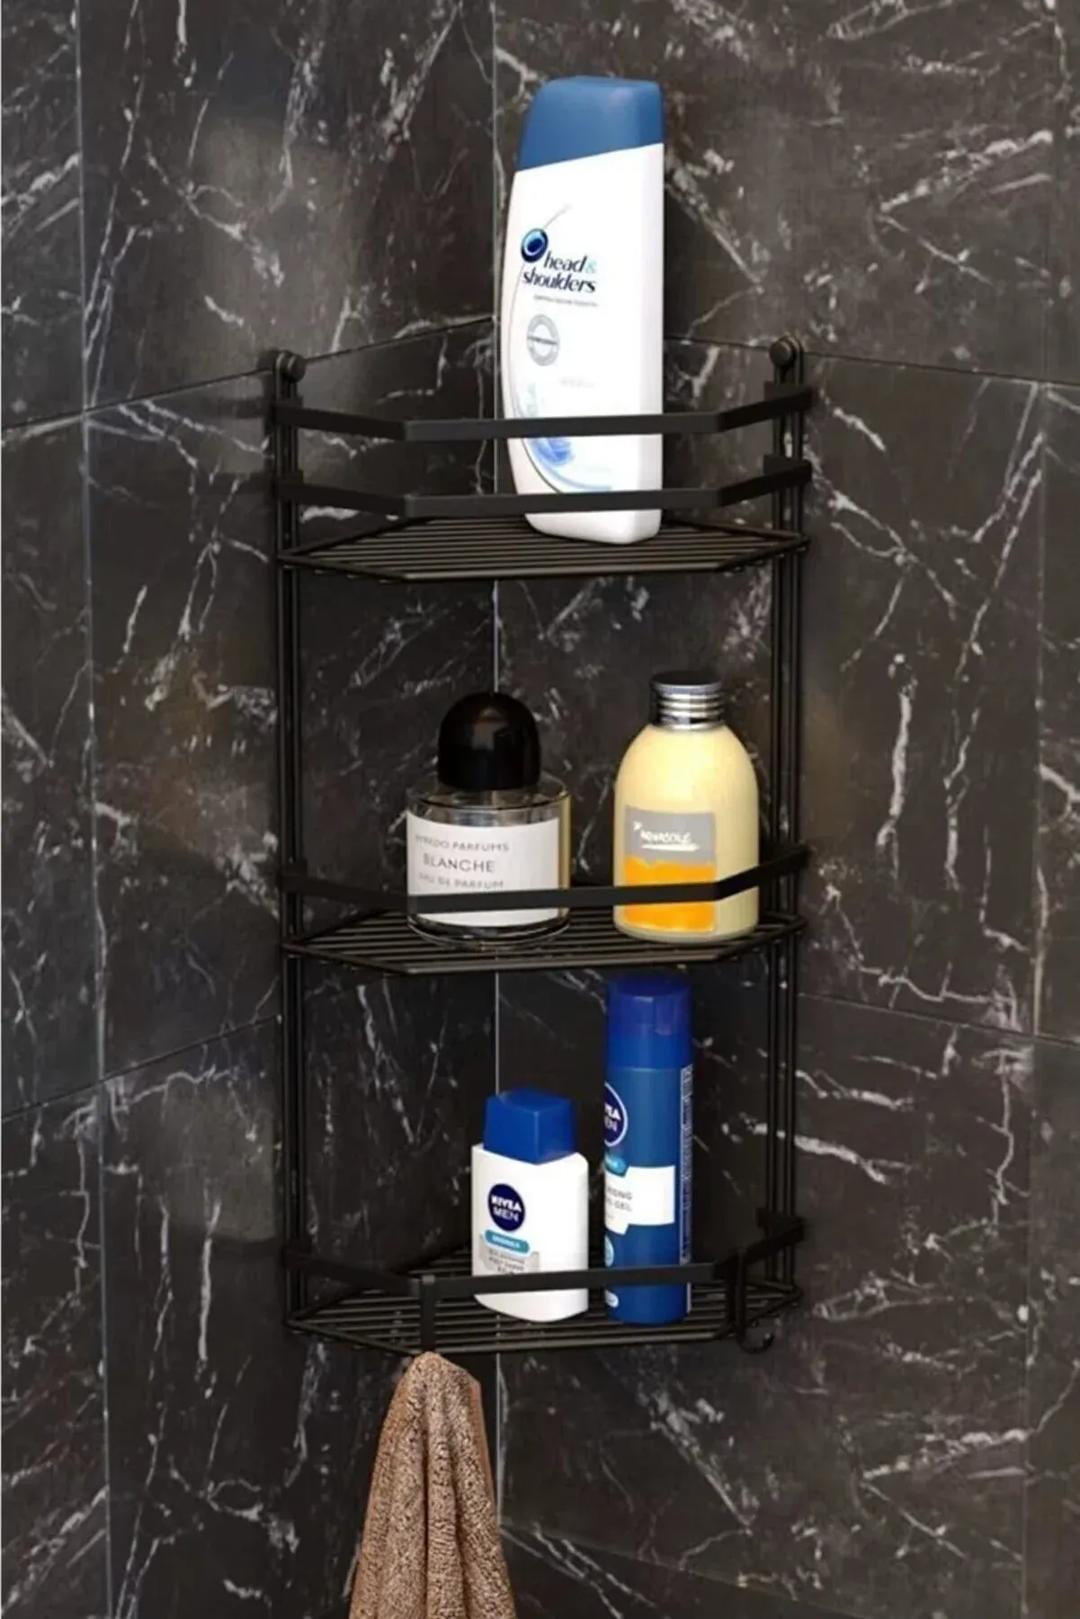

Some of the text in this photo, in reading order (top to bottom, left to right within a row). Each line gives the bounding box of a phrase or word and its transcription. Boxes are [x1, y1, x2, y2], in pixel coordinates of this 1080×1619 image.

[523, 266, 596, 293] shoulders
[453, 841, 510, 852] PARFUMS
[423, 852, 495, 873] BLANCHE
[454, 878, 504, 889] PARFUM
[491, 1194, 522, 1213] NIVEA
[493, 1206, 519, 1222] MEN
